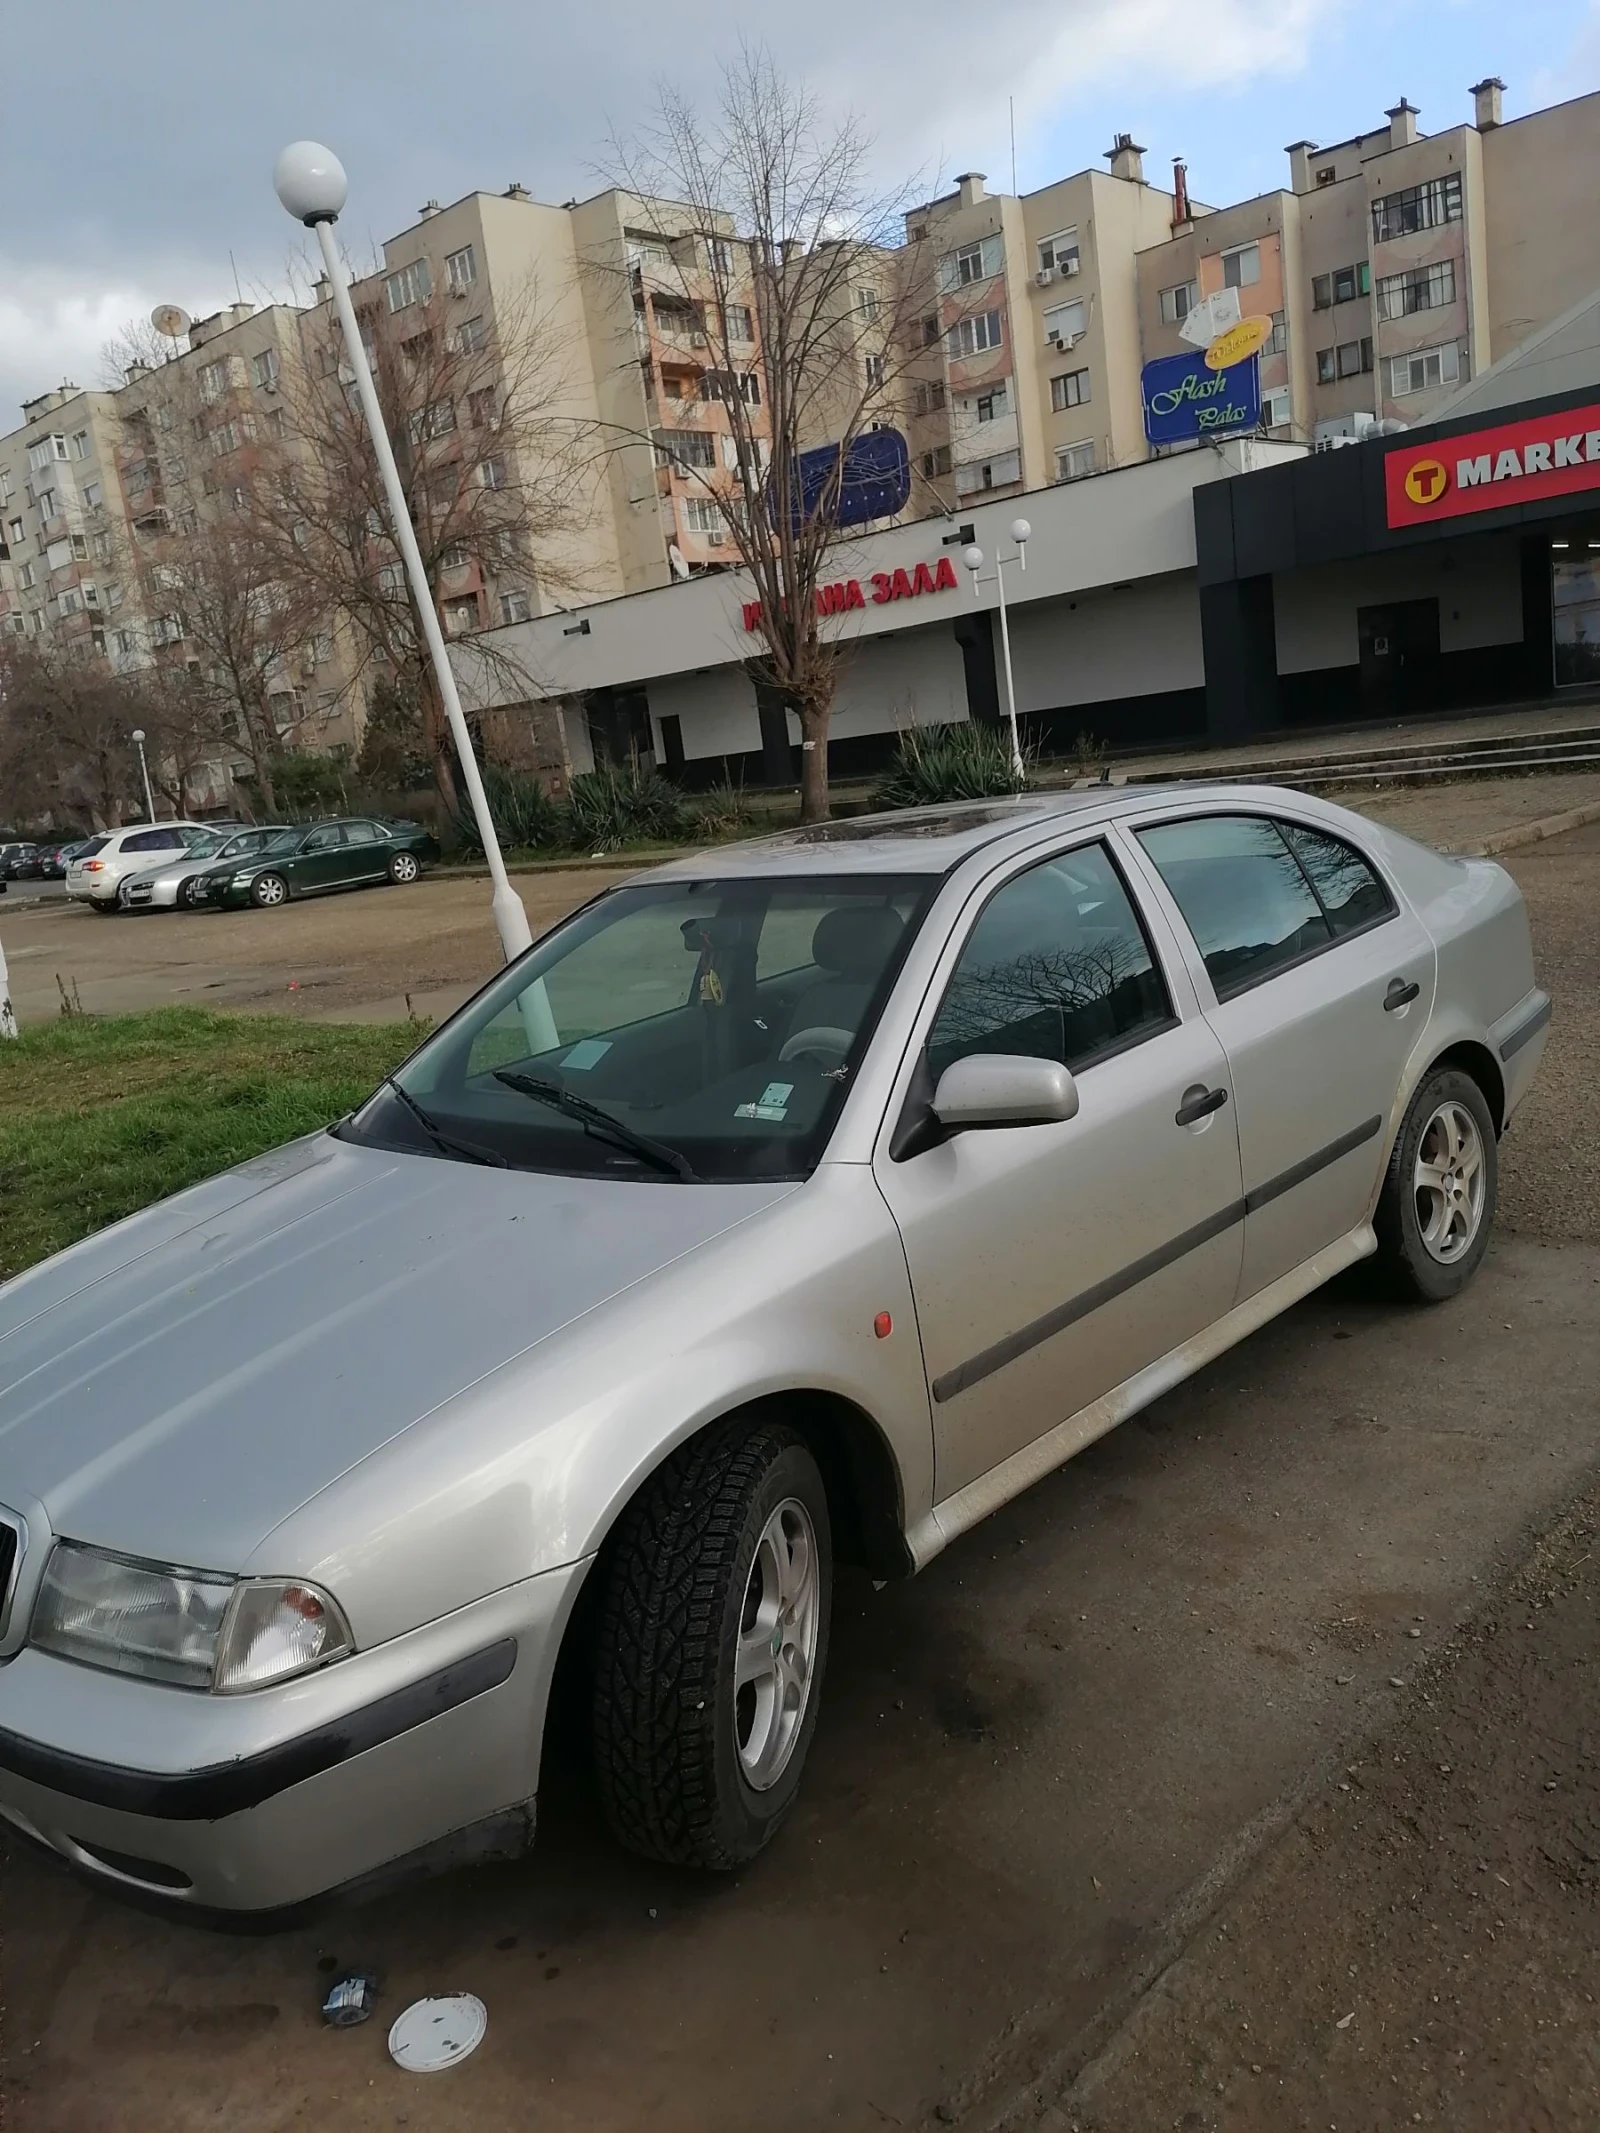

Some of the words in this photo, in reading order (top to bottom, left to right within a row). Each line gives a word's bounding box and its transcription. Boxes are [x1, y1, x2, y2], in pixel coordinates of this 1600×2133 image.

[1151, 369, 1227, 415] Flash
[1195, 402, 1247, 430] Palas
[1412, 467, 1439, 498] T
[870, 557, 958, 604] ЗАЛА
